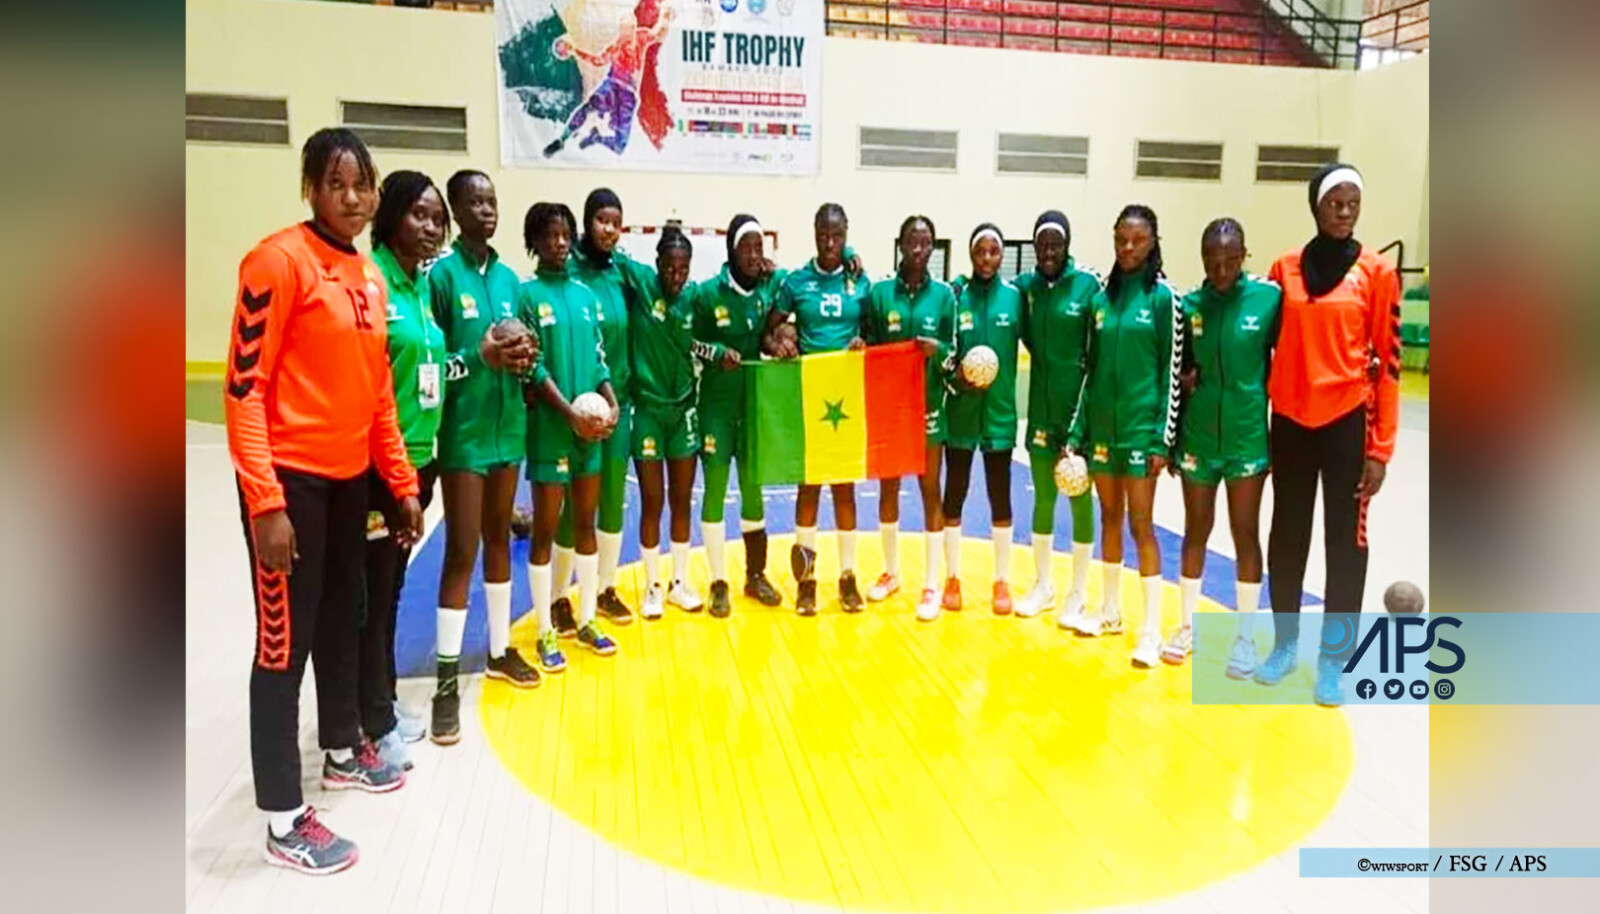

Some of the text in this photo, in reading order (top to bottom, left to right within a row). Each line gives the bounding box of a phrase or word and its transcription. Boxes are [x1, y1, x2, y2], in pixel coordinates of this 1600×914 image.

[682, 30, 805, 68] IHF TROPHY
[345, 287, 373, 330] 12
[820, 293, 842, 317] 29
